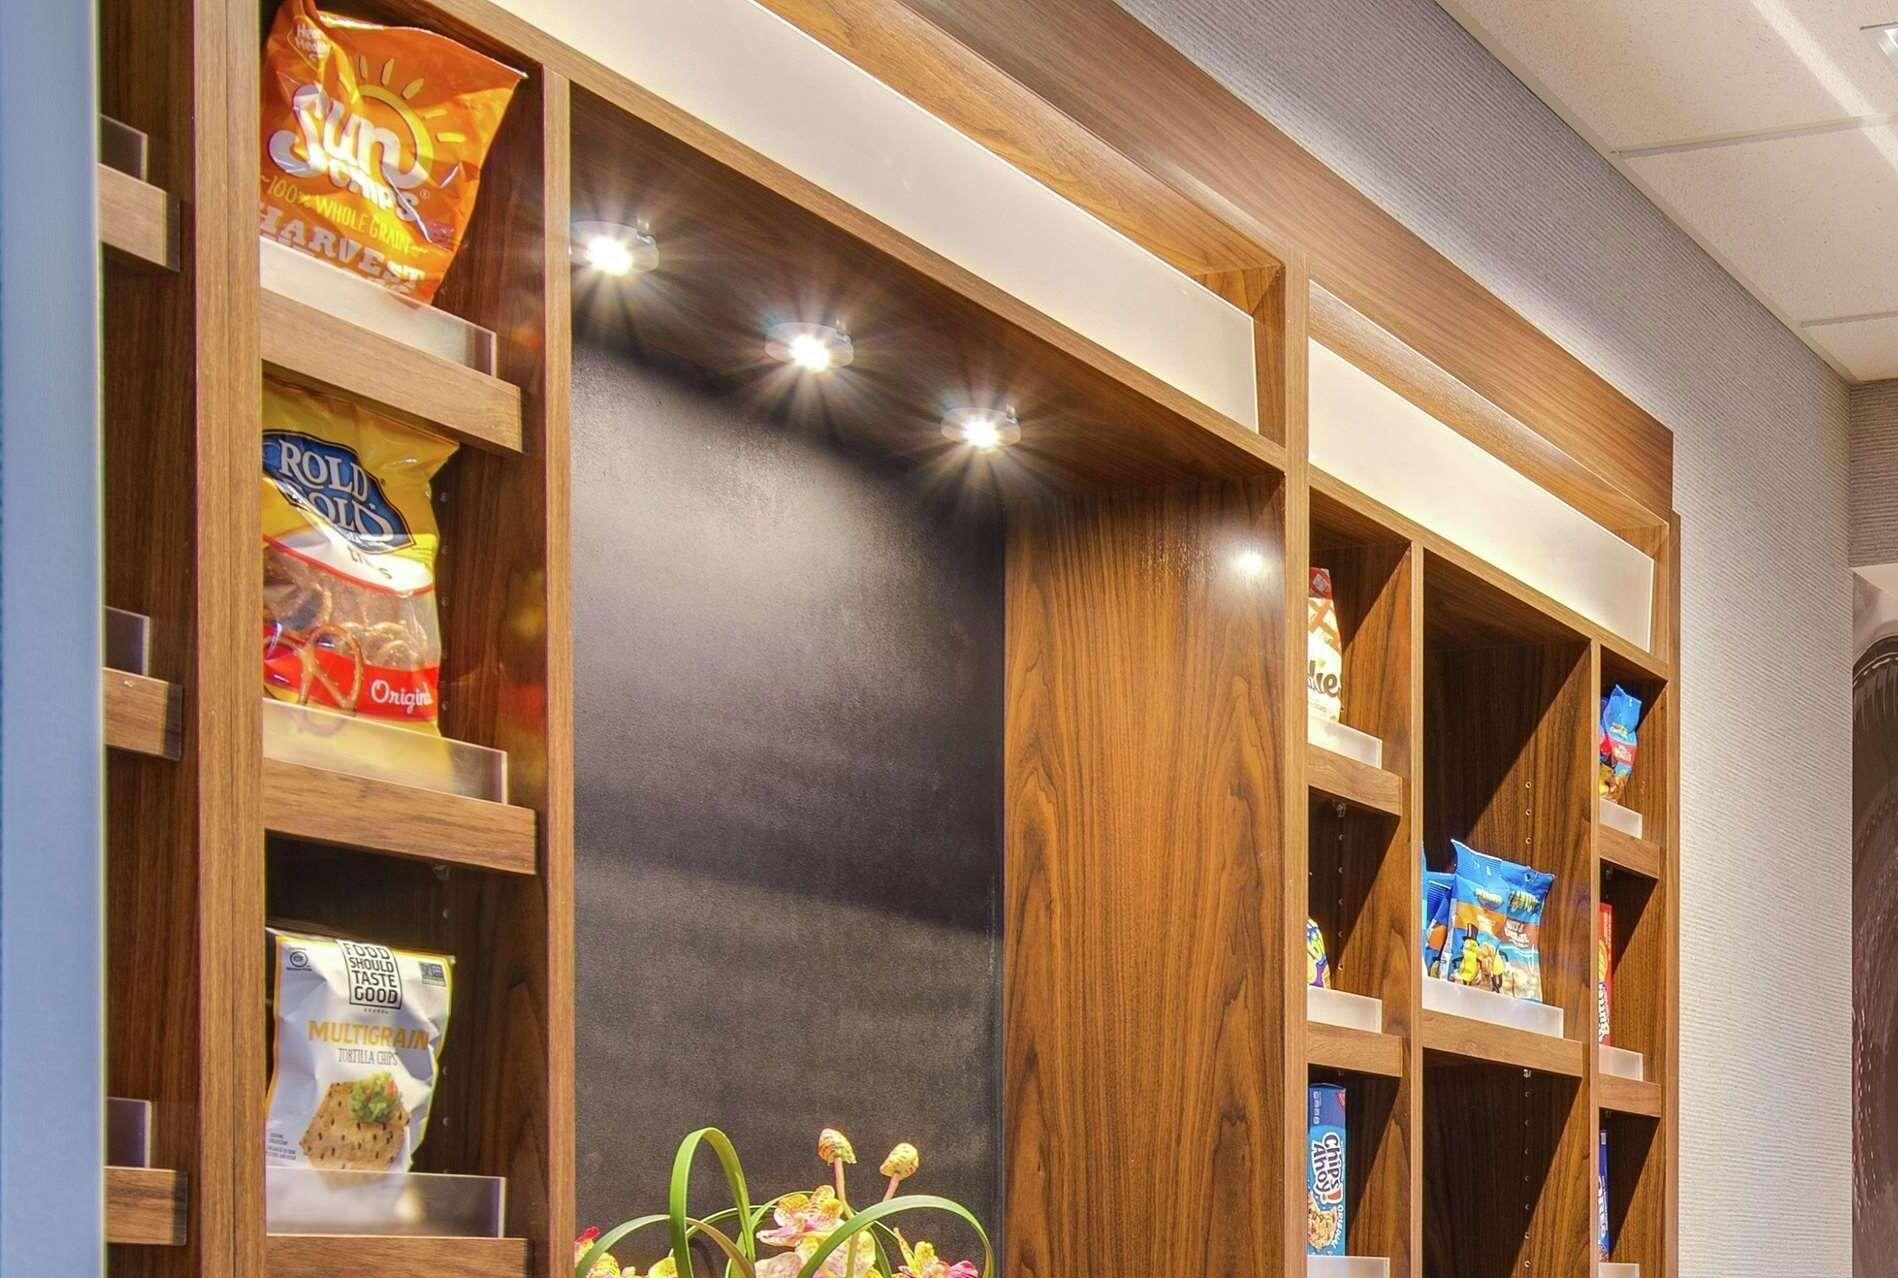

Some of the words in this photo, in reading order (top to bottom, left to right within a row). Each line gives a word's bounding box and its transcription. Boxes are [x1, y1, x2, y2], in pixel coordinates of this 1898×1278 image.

[269, 82, 429, 190] Sun
[314, 195, 366, 232] WHOLE
[368, 214, 413, 254] GRAIN
[278, 440, 369, 501] ROLD
[343, 942, 391, 960] FOOD
[348, 956, 395, 973] SHOULD
[352, 970, 398, 988] TASTE
[354, 986, 398, 1004] GOOD
[307, 1019, 430, 1050] MULTIGRAIN
[338, 1047, 375, 1065] TORTILLA
[1323, 1134, 1340, 1190] Chips
